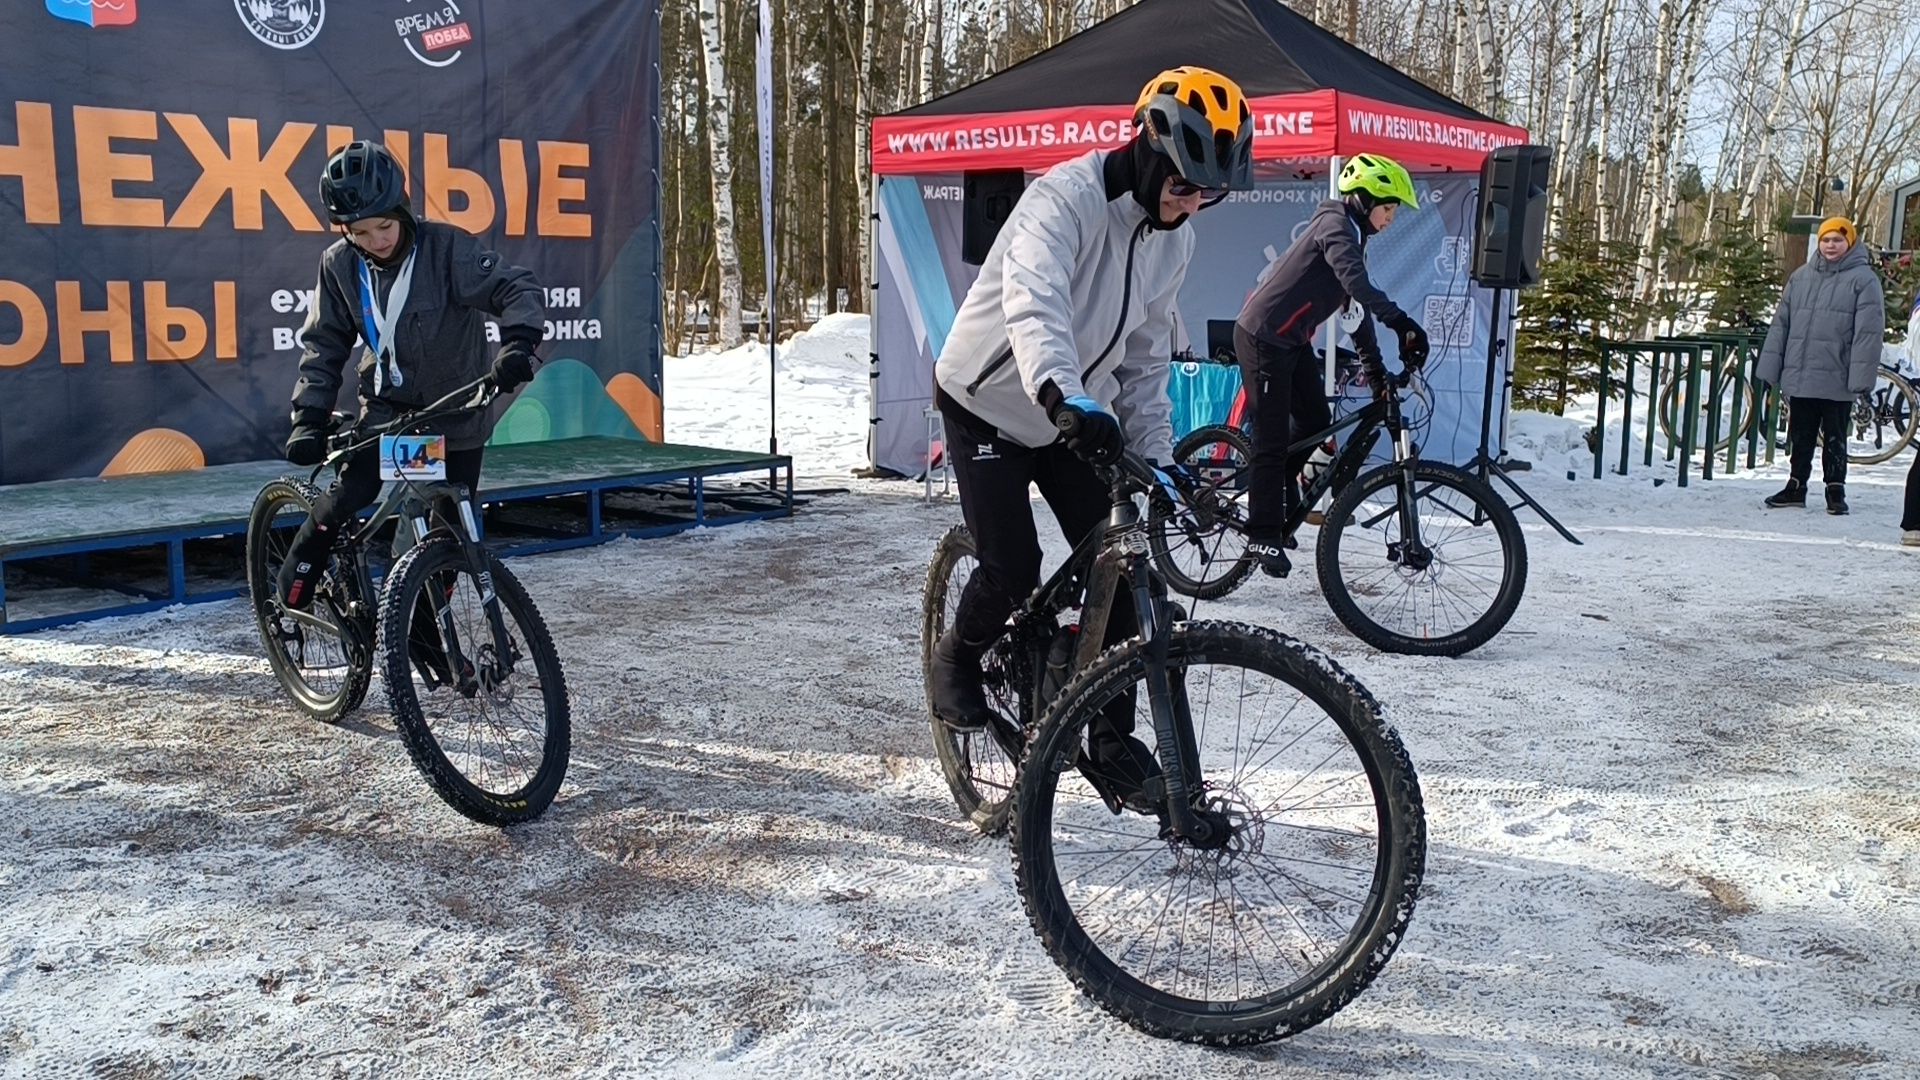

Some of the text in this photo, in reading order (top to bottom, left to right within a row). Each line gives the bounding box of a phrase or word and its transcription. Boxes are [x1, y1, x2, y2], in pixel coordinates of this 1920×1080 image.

[395, 7, 455, 36] ВРЕМЯ
[425, 26, 470, 47] ПОБЕД
[542, 319, 602, 341] онка
[399, 443, 428, 465] 14
